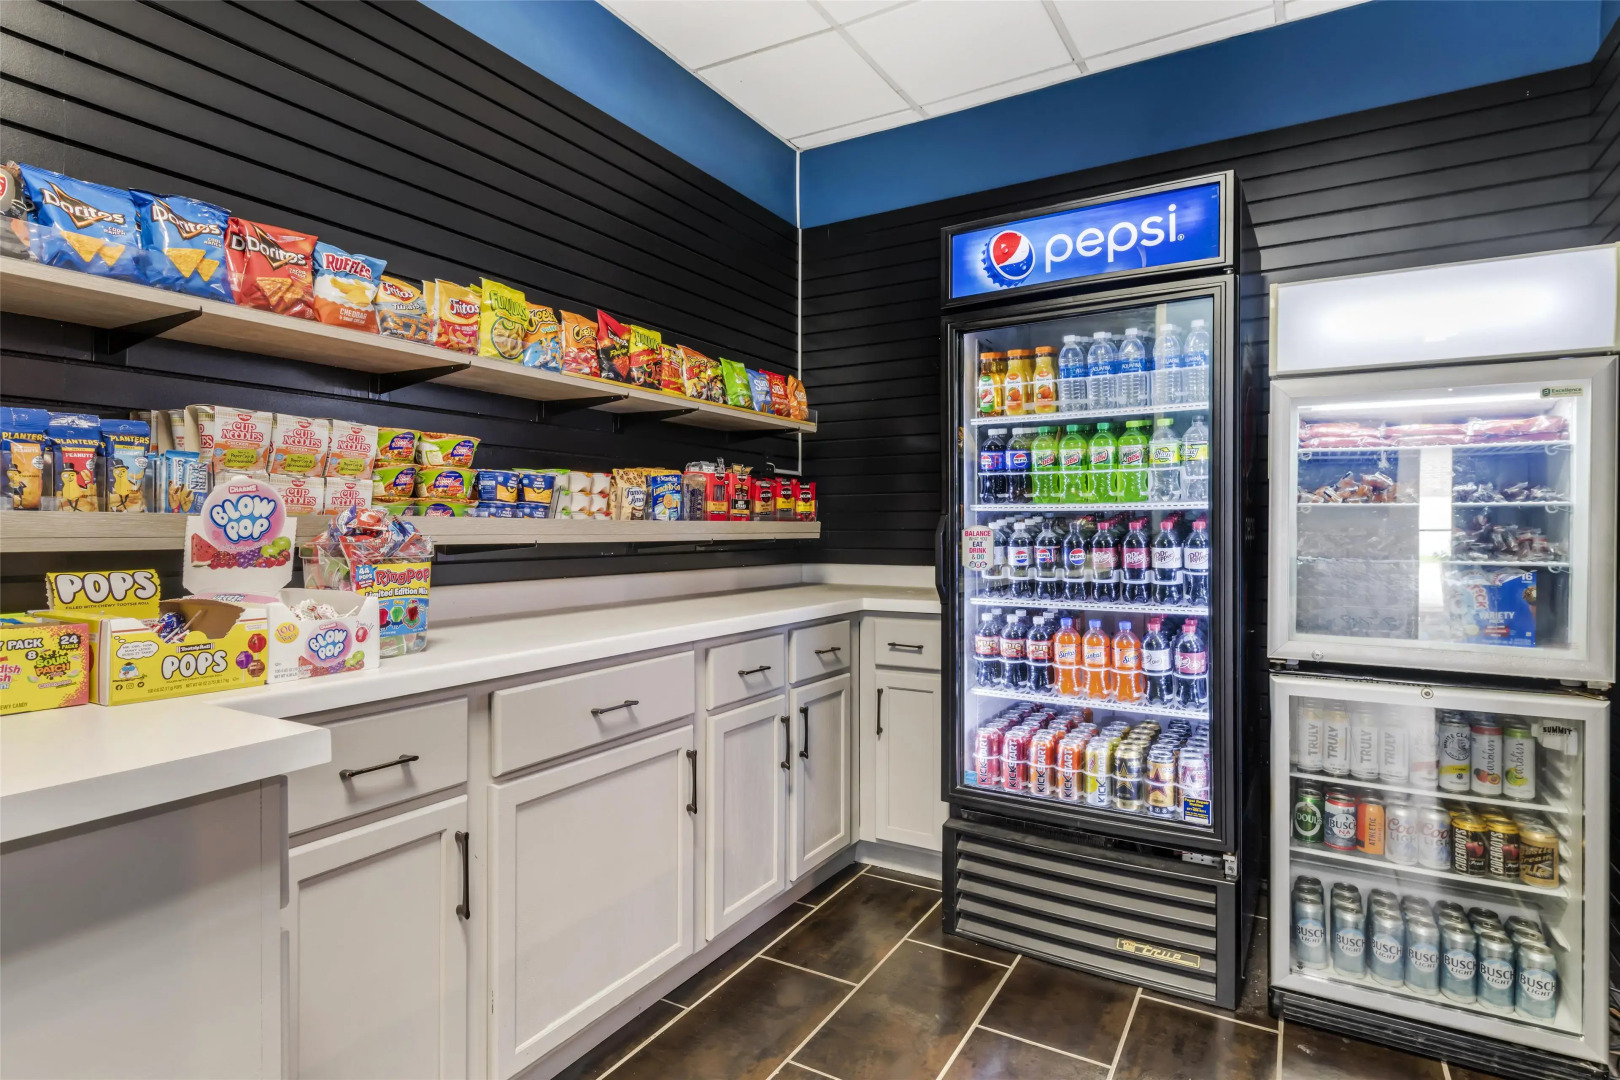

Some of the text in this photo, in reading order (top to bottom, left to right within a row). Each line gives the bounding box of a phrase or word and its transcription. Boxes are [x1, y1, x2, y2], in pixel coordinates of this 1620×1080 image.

[43, 189, 125, 224] Doritos
[151, 204, 221, 236] Doritos
[1045, 203, 1177, 273] pepsi
[246, 237, 307, 266] Doritos
[323, 253, 373, 281] RUFFLES
[382, 282, 414, 299] Fritos
[339, 307, 367, 319] CHEDDAR
[450, 299, 480, 315] Fritos
[231, 421, 257, 433] CUP
[293, 428, 315, 438] CUP
[110, 435, 150, 445] PLANTERS
[221, 429, 264, 442] NOODLES
[282, 435, 322, 448] NOODLES
[346, 433, 366, 443] CUP
[337, 440, 371, 452] NOODLES
[286, 487, 309, 496] CUP
[340, 489, 360, 498] CUP
[331, 496, 366, 507] NOODLES
[211, 495, 276, 527] BLOW
[224, 518, 271, 543] POP
[1521, 572, 1533, 581] 16
[55, 571, 158, 604] POPS
[394, 587, 417, 596] Edition
[418, 587, 428, 595] Mix
[1479, 611, 1515, 619] VARIETY
[276, 624, 296, 637] 100
[7, 638, 43, 651] PACK
[60, 634, 79, 645] 24
[309, 629, 348, 653] BLOW
[26, 651, 38, 660] 8
[317, 642, 345, 661] POP
[36, 656, 69, 668] SOUR
[162, 650, 228, 680] POPS
[35, 662, 71, 677] PATCH
[1543, 725, 1573, 735] SUMMIT
[1308, 723, 1319, 756] TRULY
[1328, 726, 1339, 759] TRULY
[1361, 730, 1372, 763] TRULY
[1384, 732, 1396, 766] TRULY
[1329, 817, 1356, 831] BUSCH
[1420, 822, 1450, 840] Coo
[1369, 817, 1377, 846] ATHLETIC
[1455, 828, 1467, 871] CIDERBOYS
[1490, 831, 1504, 874] CIDERBOYS
[1297, 924, 1325, 938] BUSCH
[1301, 935, 1320, 944] LIGHT
[1336, 933, 1365, 948] BUSCH
[1341, 944, 1362, 953] LIGHT
[1371, 938, 1402, 956] BUSCH
[1375, 951, 1396, 960] LIGHT
[1408, 947, 1440, 964] BUSCH
[1444, 954, 1477, 970] BUSCH
[1414, 960, 1436, 969] LIGHT
[1450, 967, 1473, 976] LIGHT
[1480, 963, 1515, 980] BUSCH
[1486, 976, 1510, 985] LIGHT
[1520, 973, 1557, 992] BUSCH
[1526, 987, 1551, 997] LIGHT
